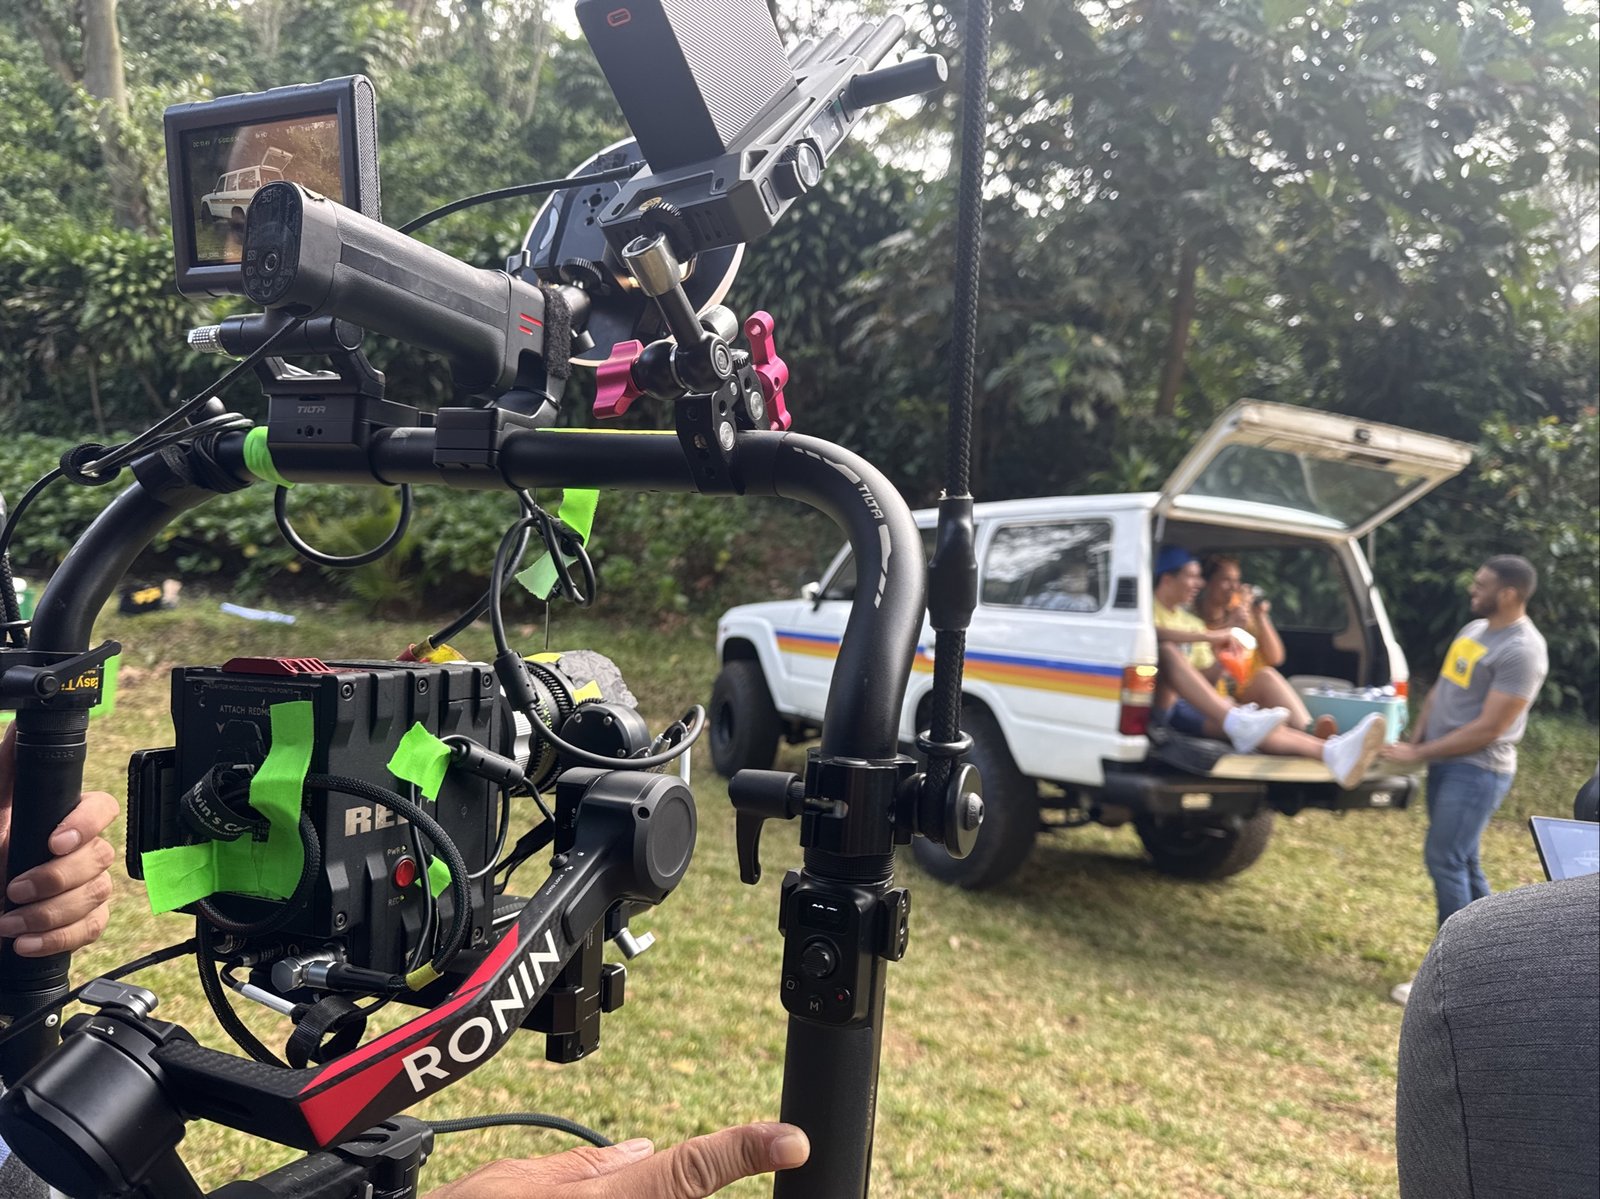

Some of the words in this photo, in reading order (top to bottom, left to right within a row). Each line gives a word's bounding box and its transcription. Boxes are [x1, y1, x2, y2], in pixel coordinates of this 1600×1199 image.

[297, 405, 327, 414] TILTA
[858, 483, 885, 519] TILTA
[219, 704, 246, 714] ATTACH
[344, 803, 409, 837] RE
[387, 848, 401, 857] PWR
[388, 897, 401, 907] REC
[401, 928, 561, 1093] RONIN
[809, 1001, 819, 1012] M
